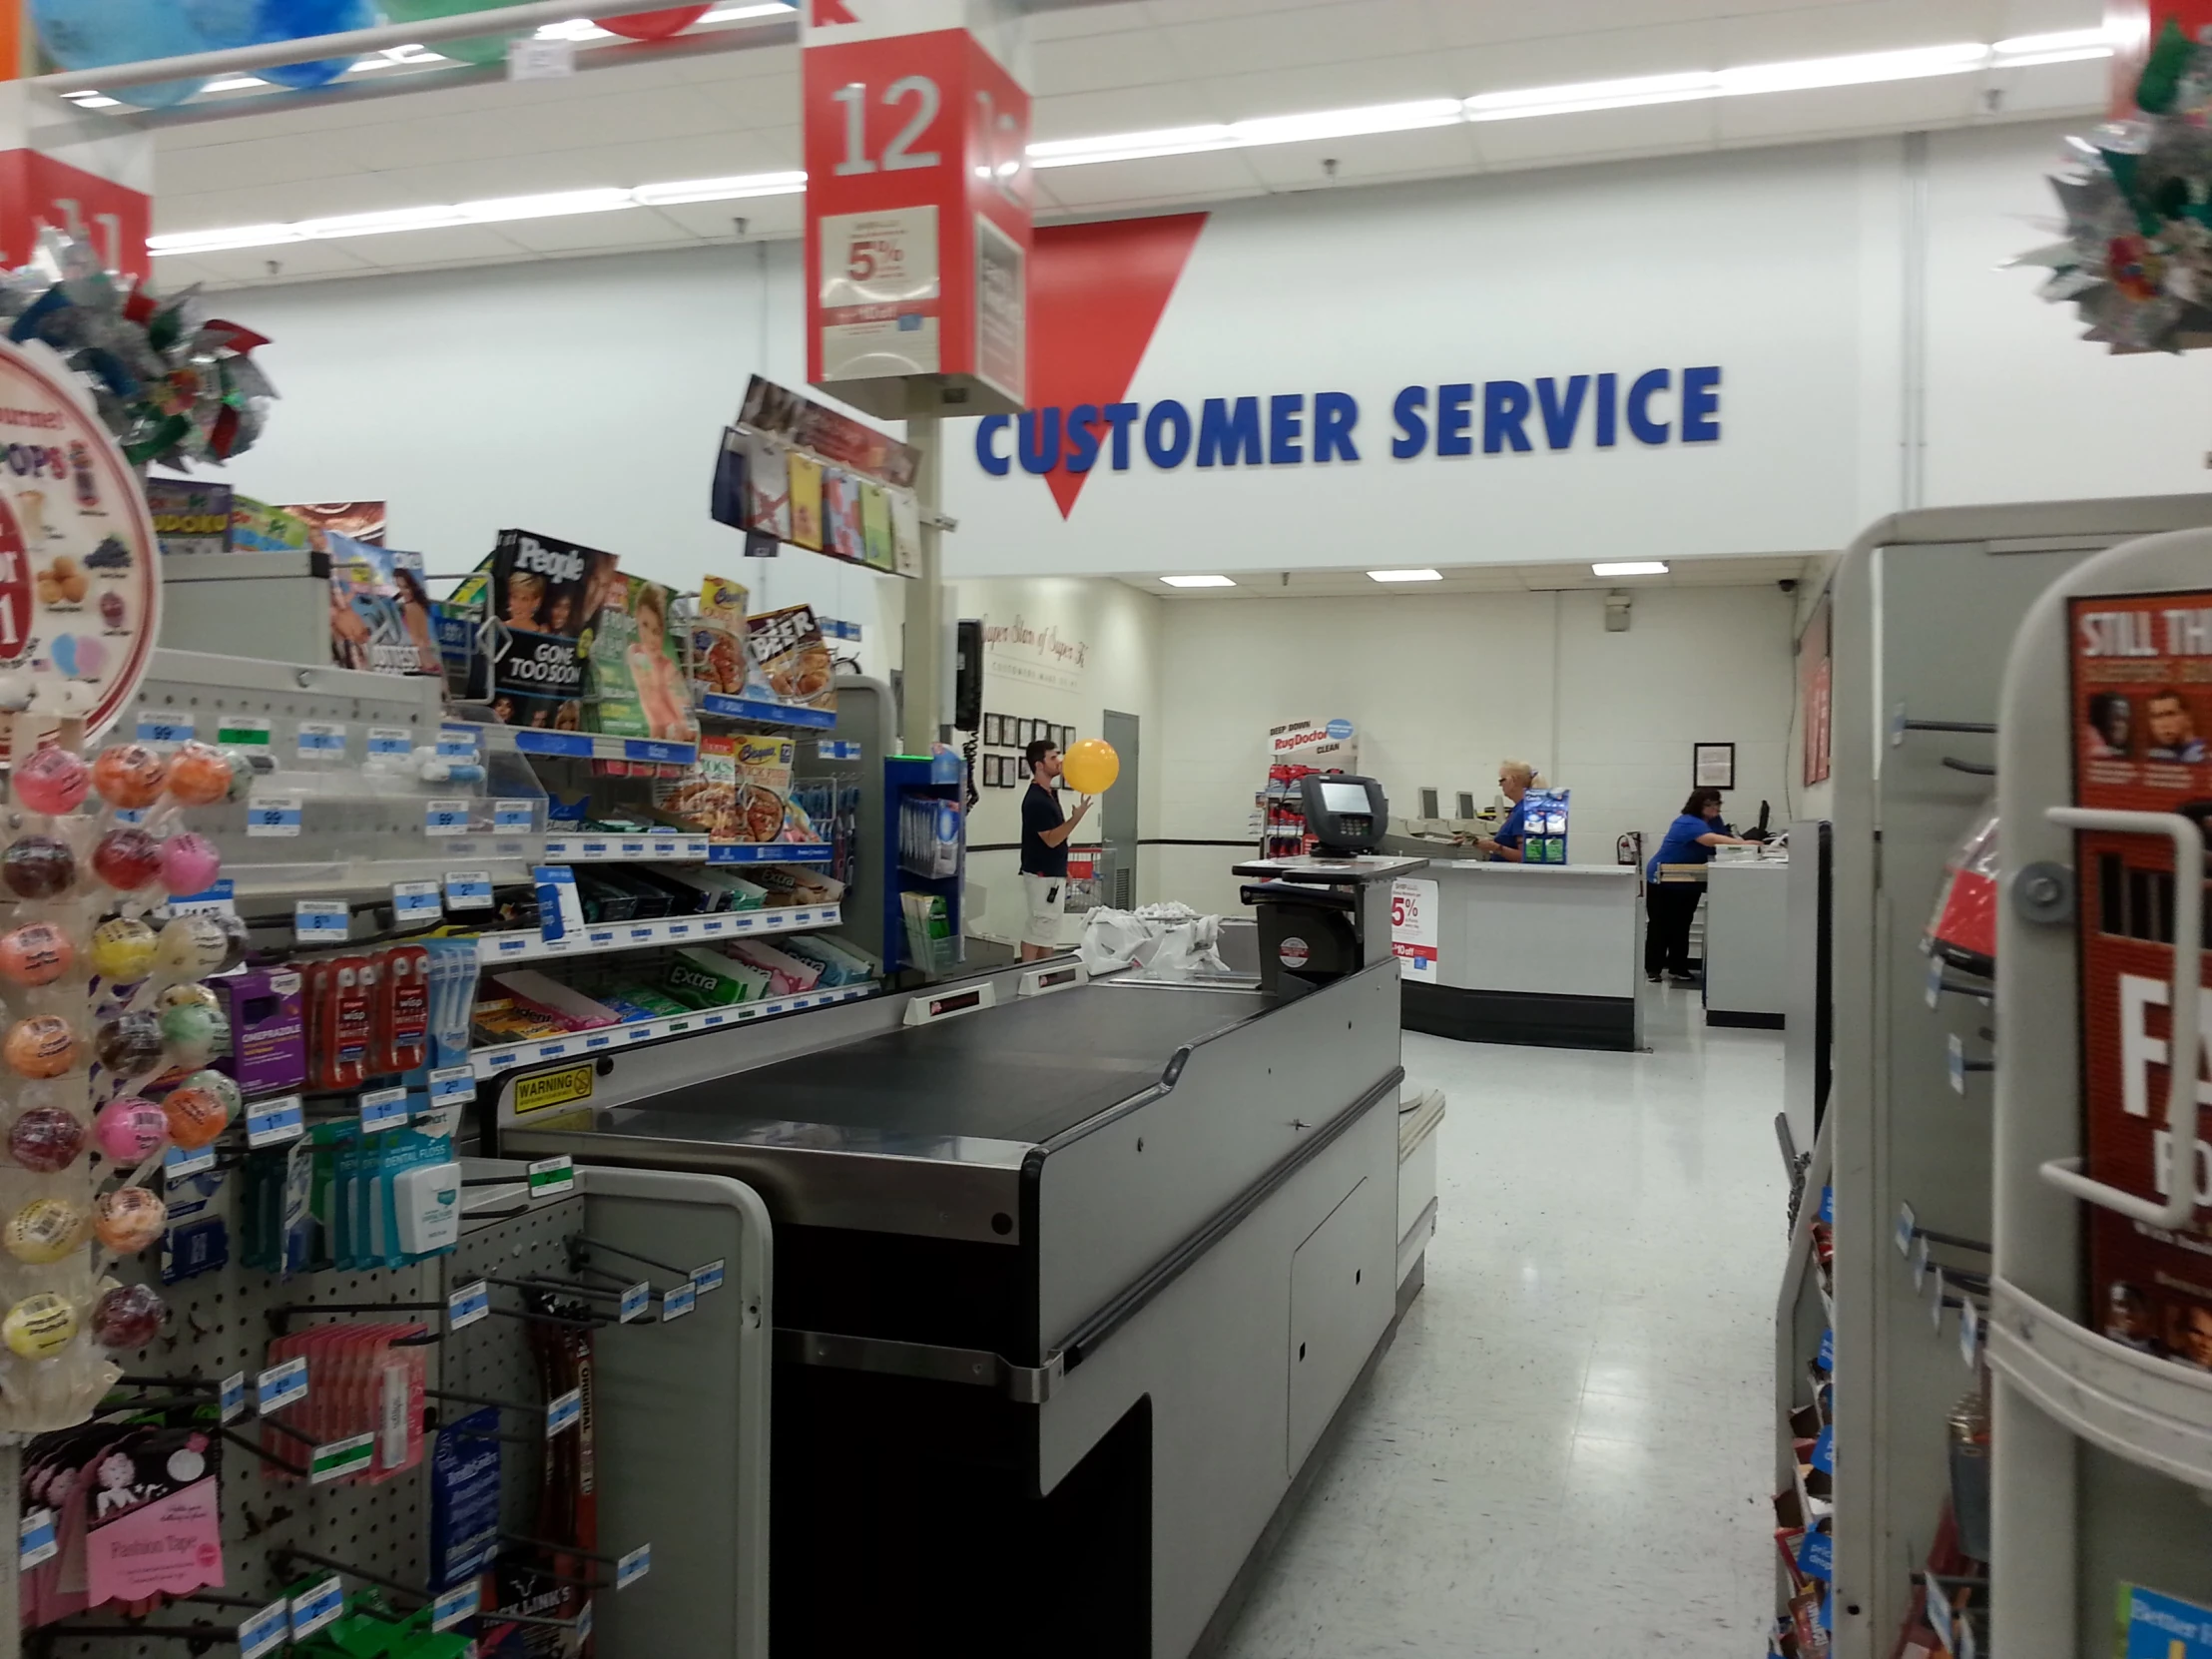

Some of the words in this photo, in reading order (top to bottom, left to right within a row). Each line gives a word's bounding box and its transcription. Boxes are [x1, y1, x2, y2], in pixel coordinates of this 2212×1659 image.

[831, 75, 941, 177] 12
[976, 391, 1362, 476] CUSTOMER
[1391, 365, 1721, 460] SERVICE
[515, 537, 586, 584] People
[750, 610, 816, 661] BEER
[2082, 611, 2159, 658] STILL
[534, 643, 577, 667] GONE
[509, 657, 550, 681] TOO
[549, 664, 582, 684] SOON
[1270, 725, 1287, 737] DEEP
[1289, 720, 1311, 733] DOWN
[1317, 742, 1340, 755] CLEAN
[762, 866, 797, 887] Extra
[1391, 896, 1418, 927] 5%
[671, 965, 719, 991] Extra
[399, 996, 423, 1008] wisp
[342, 1009, 366, 1021] wisp
[395, 1012, 427, 1025] WHITE
[339, 1026, 370, 1039] WHITE
[519, 1074, 573, 1098] WARNING
[385, 1149, 417, 1168] DENTAL
[419, 1144, 446, 1161] FLOSS
[110, 1539, 164, 1559] Fashion
[166, 1534, 198, 1554] Tape
[2130, 1598, 2197, 1638] Better
